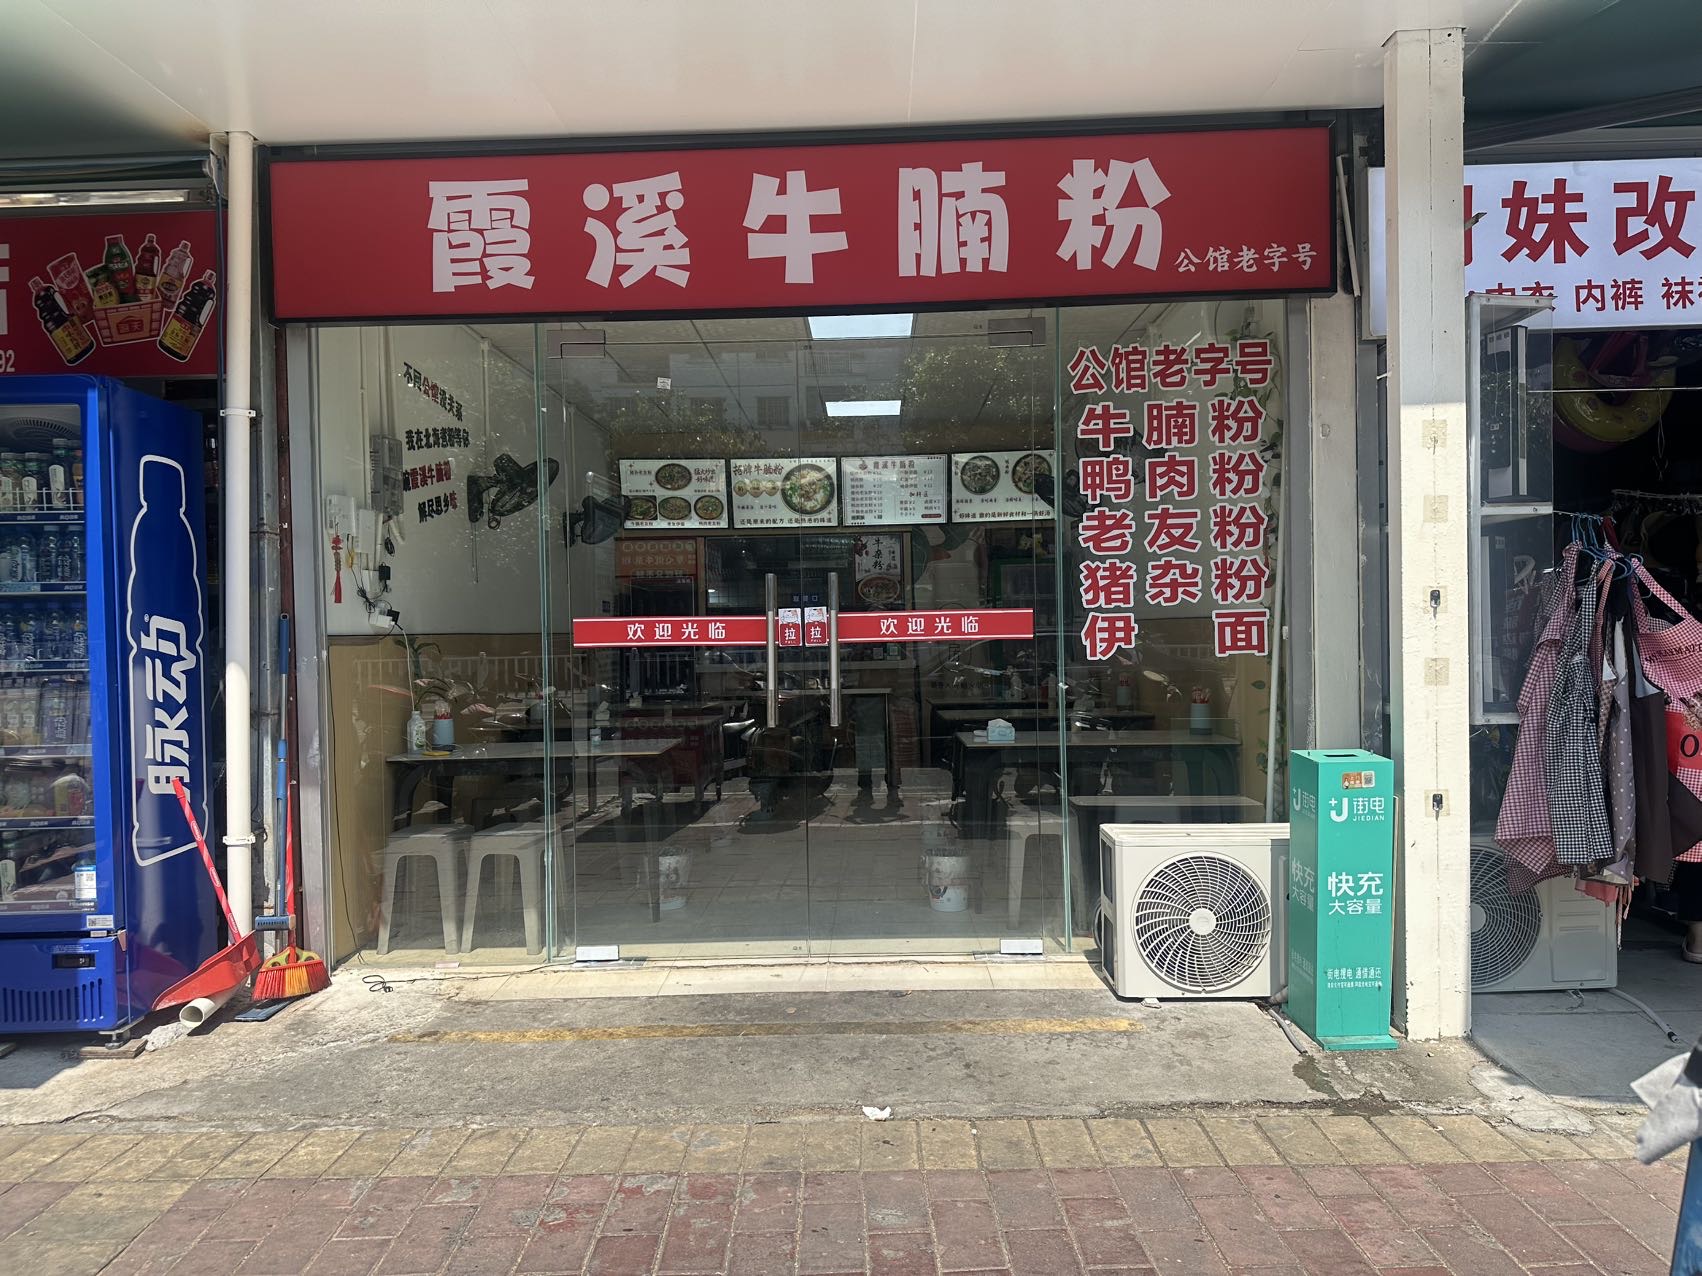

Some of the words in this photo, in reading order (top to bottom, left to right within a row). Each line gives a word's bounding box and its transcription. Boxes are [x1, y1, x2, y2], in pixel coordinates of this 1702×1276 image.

[427, 157, 1171, 292] 霞溪牛腩粉
[1464, 175, 1697, 267] 妹改
[1173, 243, 1317, 272] 公馆老字号
[1574, 278, 1644, 312] 内裤
[1661, 275, 1702, 310] 袜
[1068, 339, 1274, 394] 公馆老字号
[1078, 396, 1266, 450] 牛腩粉
[733, 463, 785, 476] 招牌牛腩粉
[1079, 450, 1266, 504] 鸭肉粉
[1079, 503, 1269, 555] 老友粉
[1080, 556, 1269, 608] 猪杂粉
[627, 622, 726, 640] 欢迎光临
[784, 627, 796, 640] 拉
[810, 625, 822, 639] 拉
[880, 616, 979, 635] 欢迎光临
[1081, 609, 1270, 661] 伊面
[140, 615, 197, 803] 脉动
[1353, 797, 1385, 815] 街电
[1291, 857, 1315, 894] 快充
[1327, 871, 1383, 898] 快充
[1328, 899, 1382, 915] 大容量
[1355, 966, 1382, 979] 通借通还
